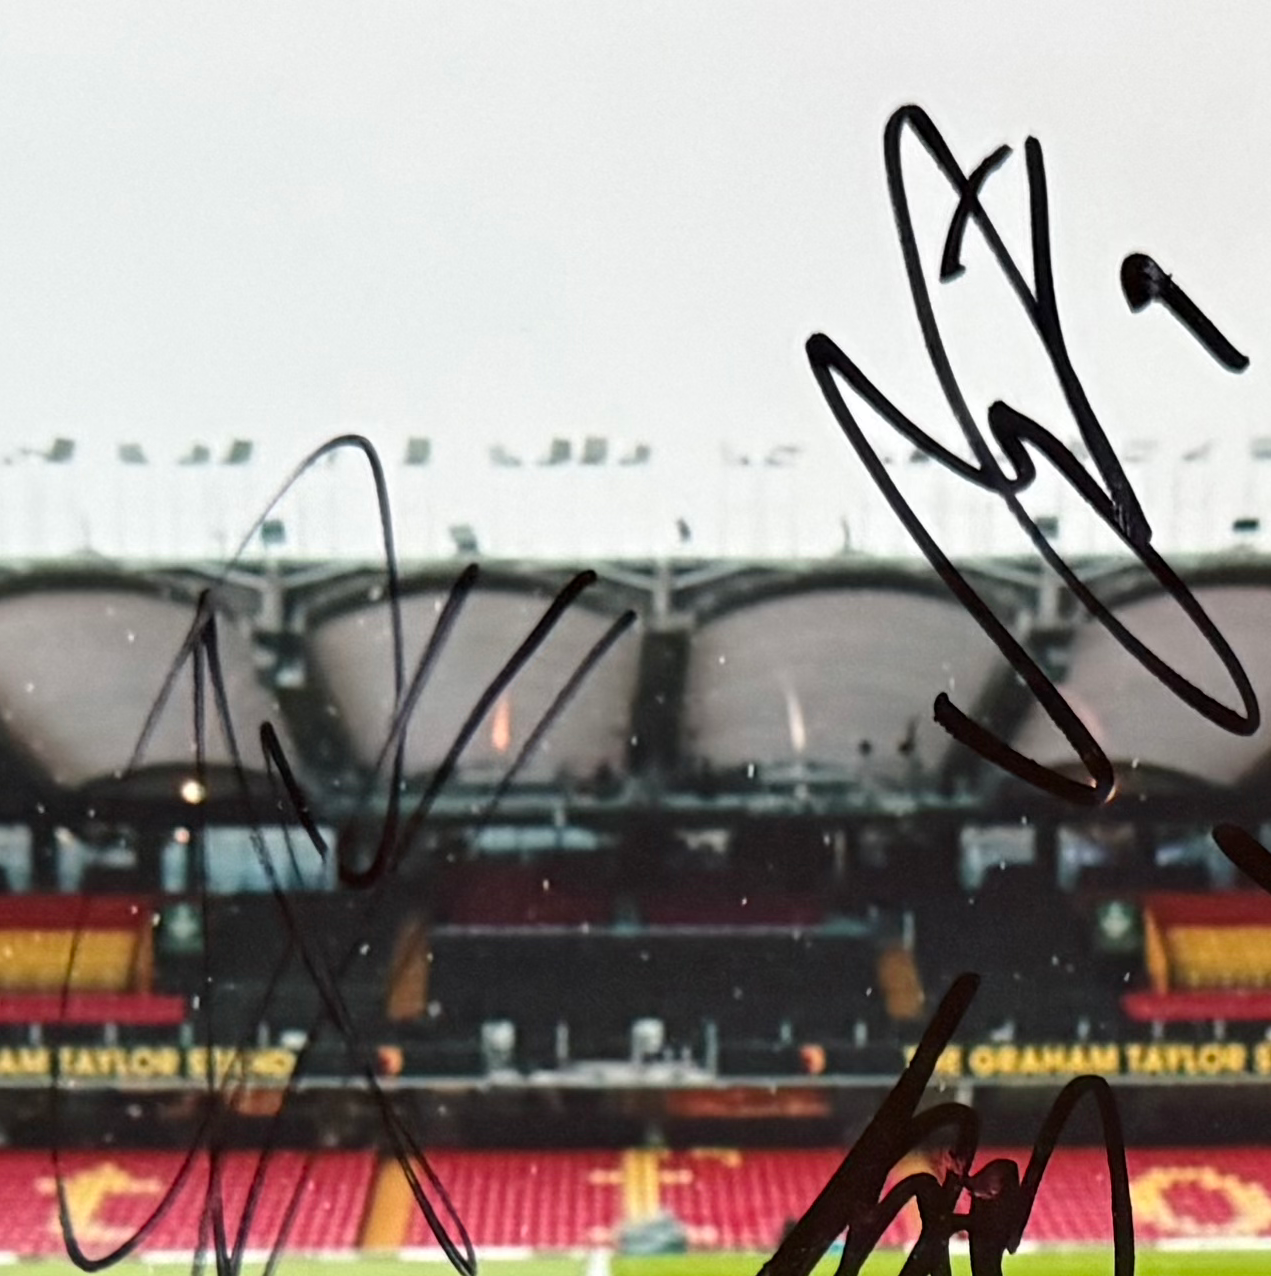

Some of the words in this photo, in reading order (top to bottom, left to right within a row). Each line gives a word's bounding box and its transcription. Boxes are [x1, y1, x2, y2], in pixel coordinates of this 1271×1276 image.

[59, 1046, 180, 1075] TAYLOR
[969, 1044, 1119, 1075] GRAHAM
[1126, 1043, 1247, 1073] TAYLOR
